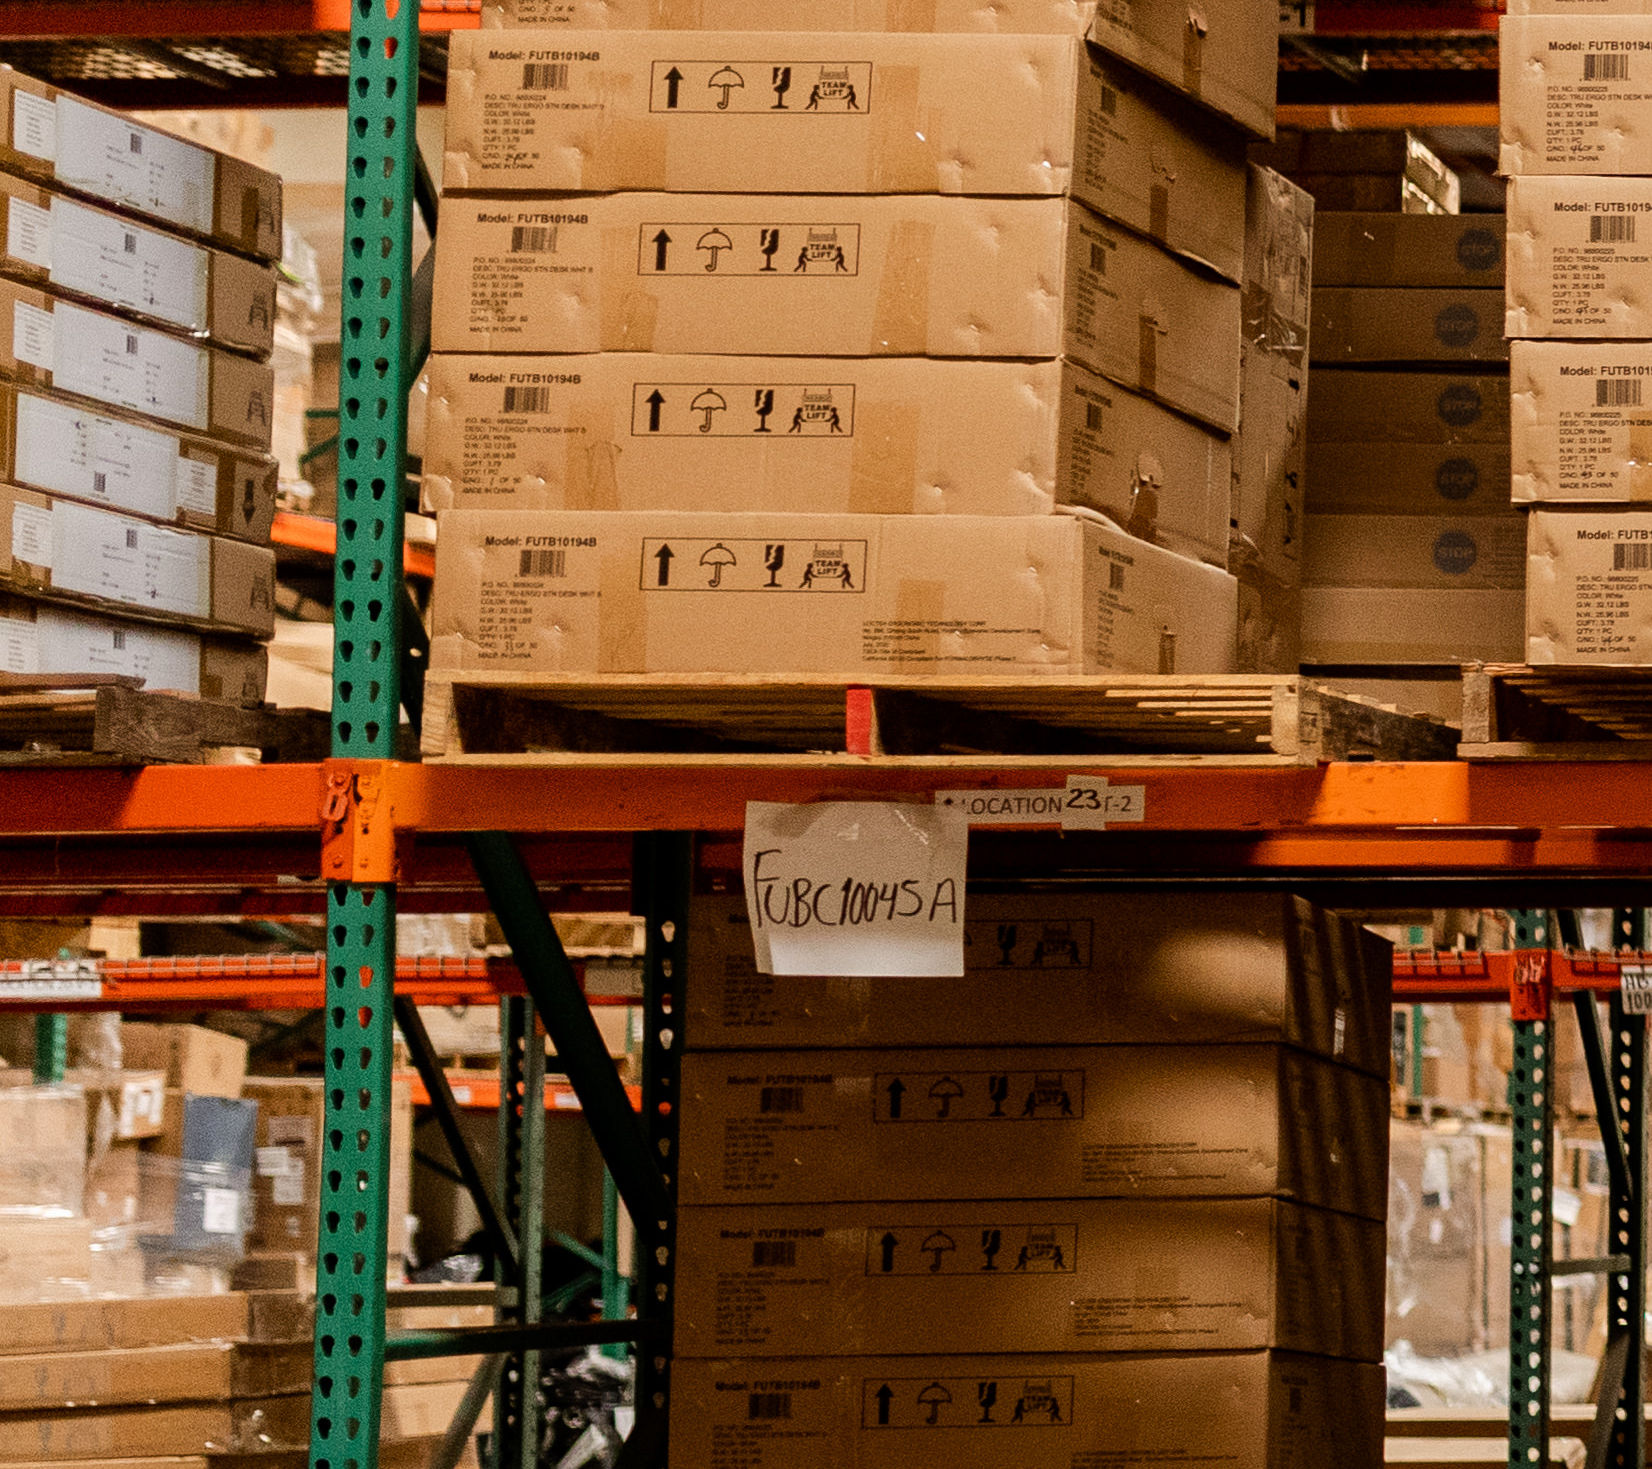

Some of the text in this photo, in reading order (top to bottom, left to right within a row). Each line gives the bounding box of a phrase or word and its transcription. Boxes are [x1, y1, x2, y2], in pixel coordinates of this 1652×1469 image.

[1549, 41, 1586, 52] Model:
[1554, 202, 1591, 213] Model:
[477, 213, 589, 226] Model: FUTB10194B
[1560, 366, 1597, 377] Model:
[1577, 529, 1614, 540] Model:
[484, 535, 597, 549] Model: FUTB10194B
[754, 849, 957, 928] FUBC10045A
